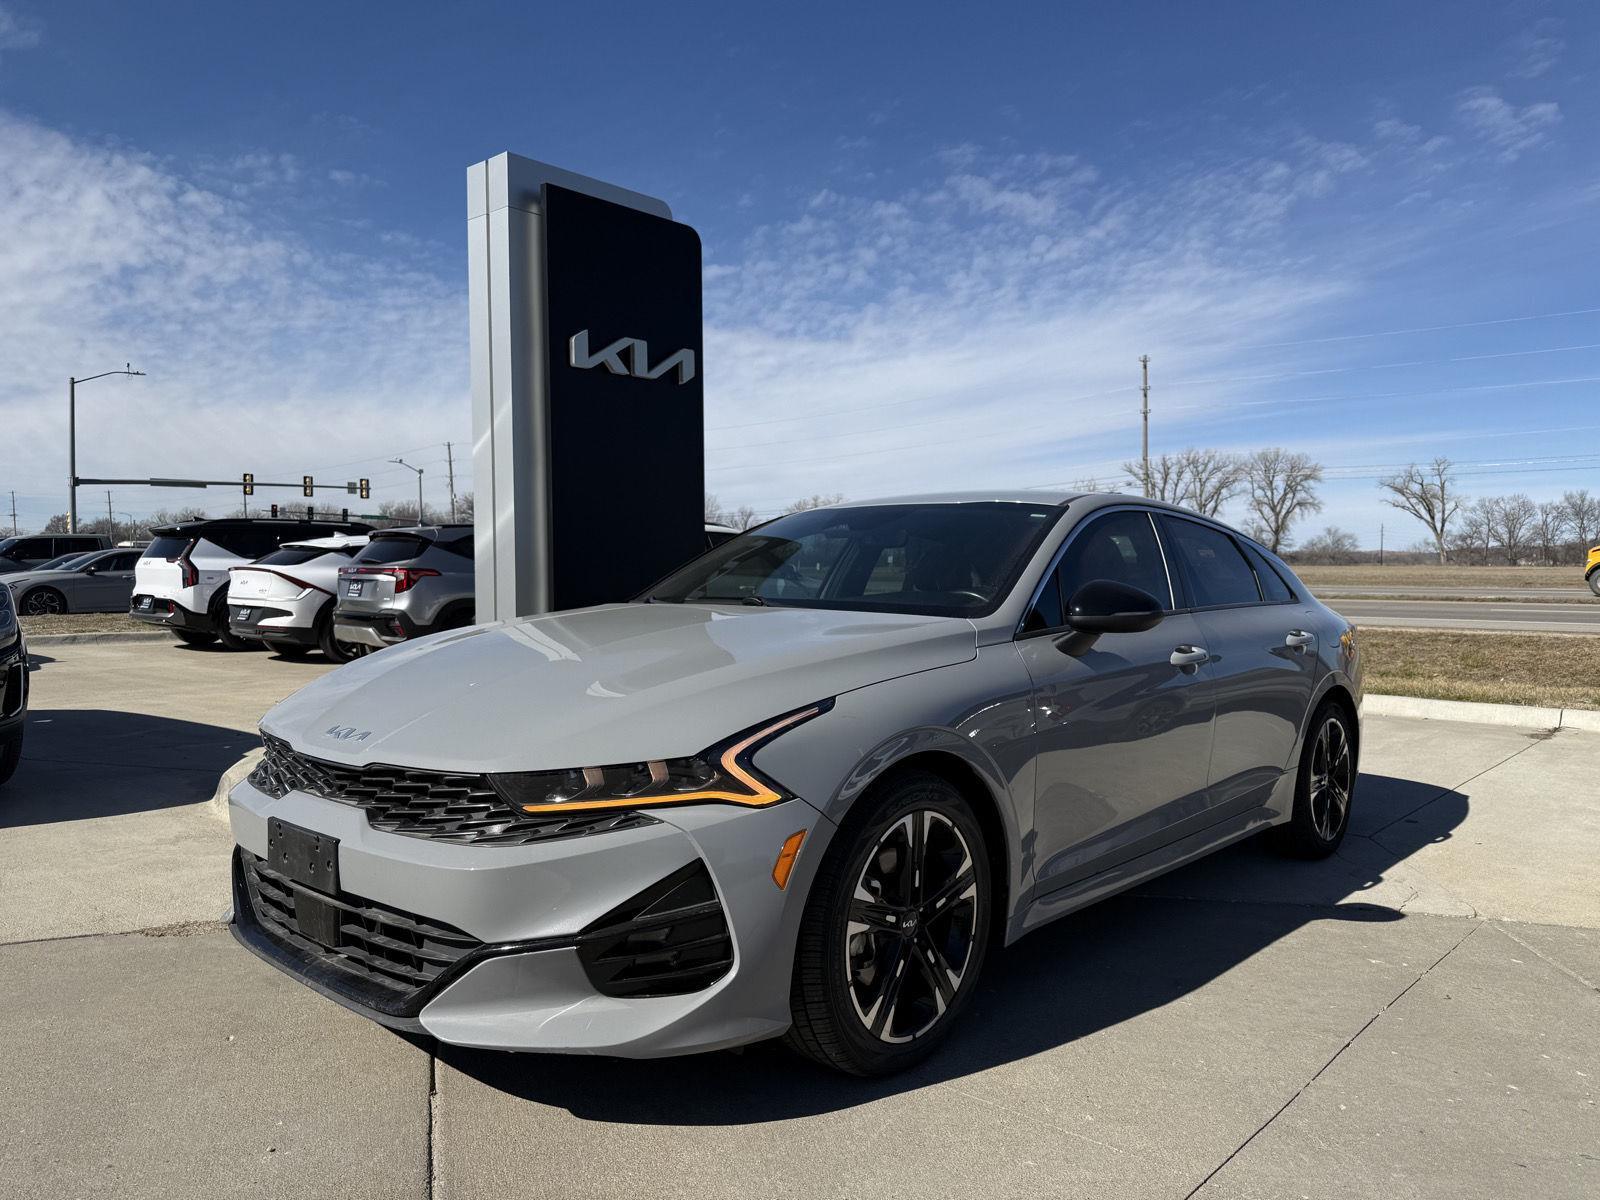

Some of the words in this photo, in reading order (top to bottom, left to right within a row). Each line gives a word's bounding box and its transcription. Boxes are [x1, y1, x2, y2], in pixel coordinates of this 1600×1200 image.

[569, 329, 695, 385] KIA
[326, 725, 371, 741] KIA
[903, 920, 917, 928] KIA
